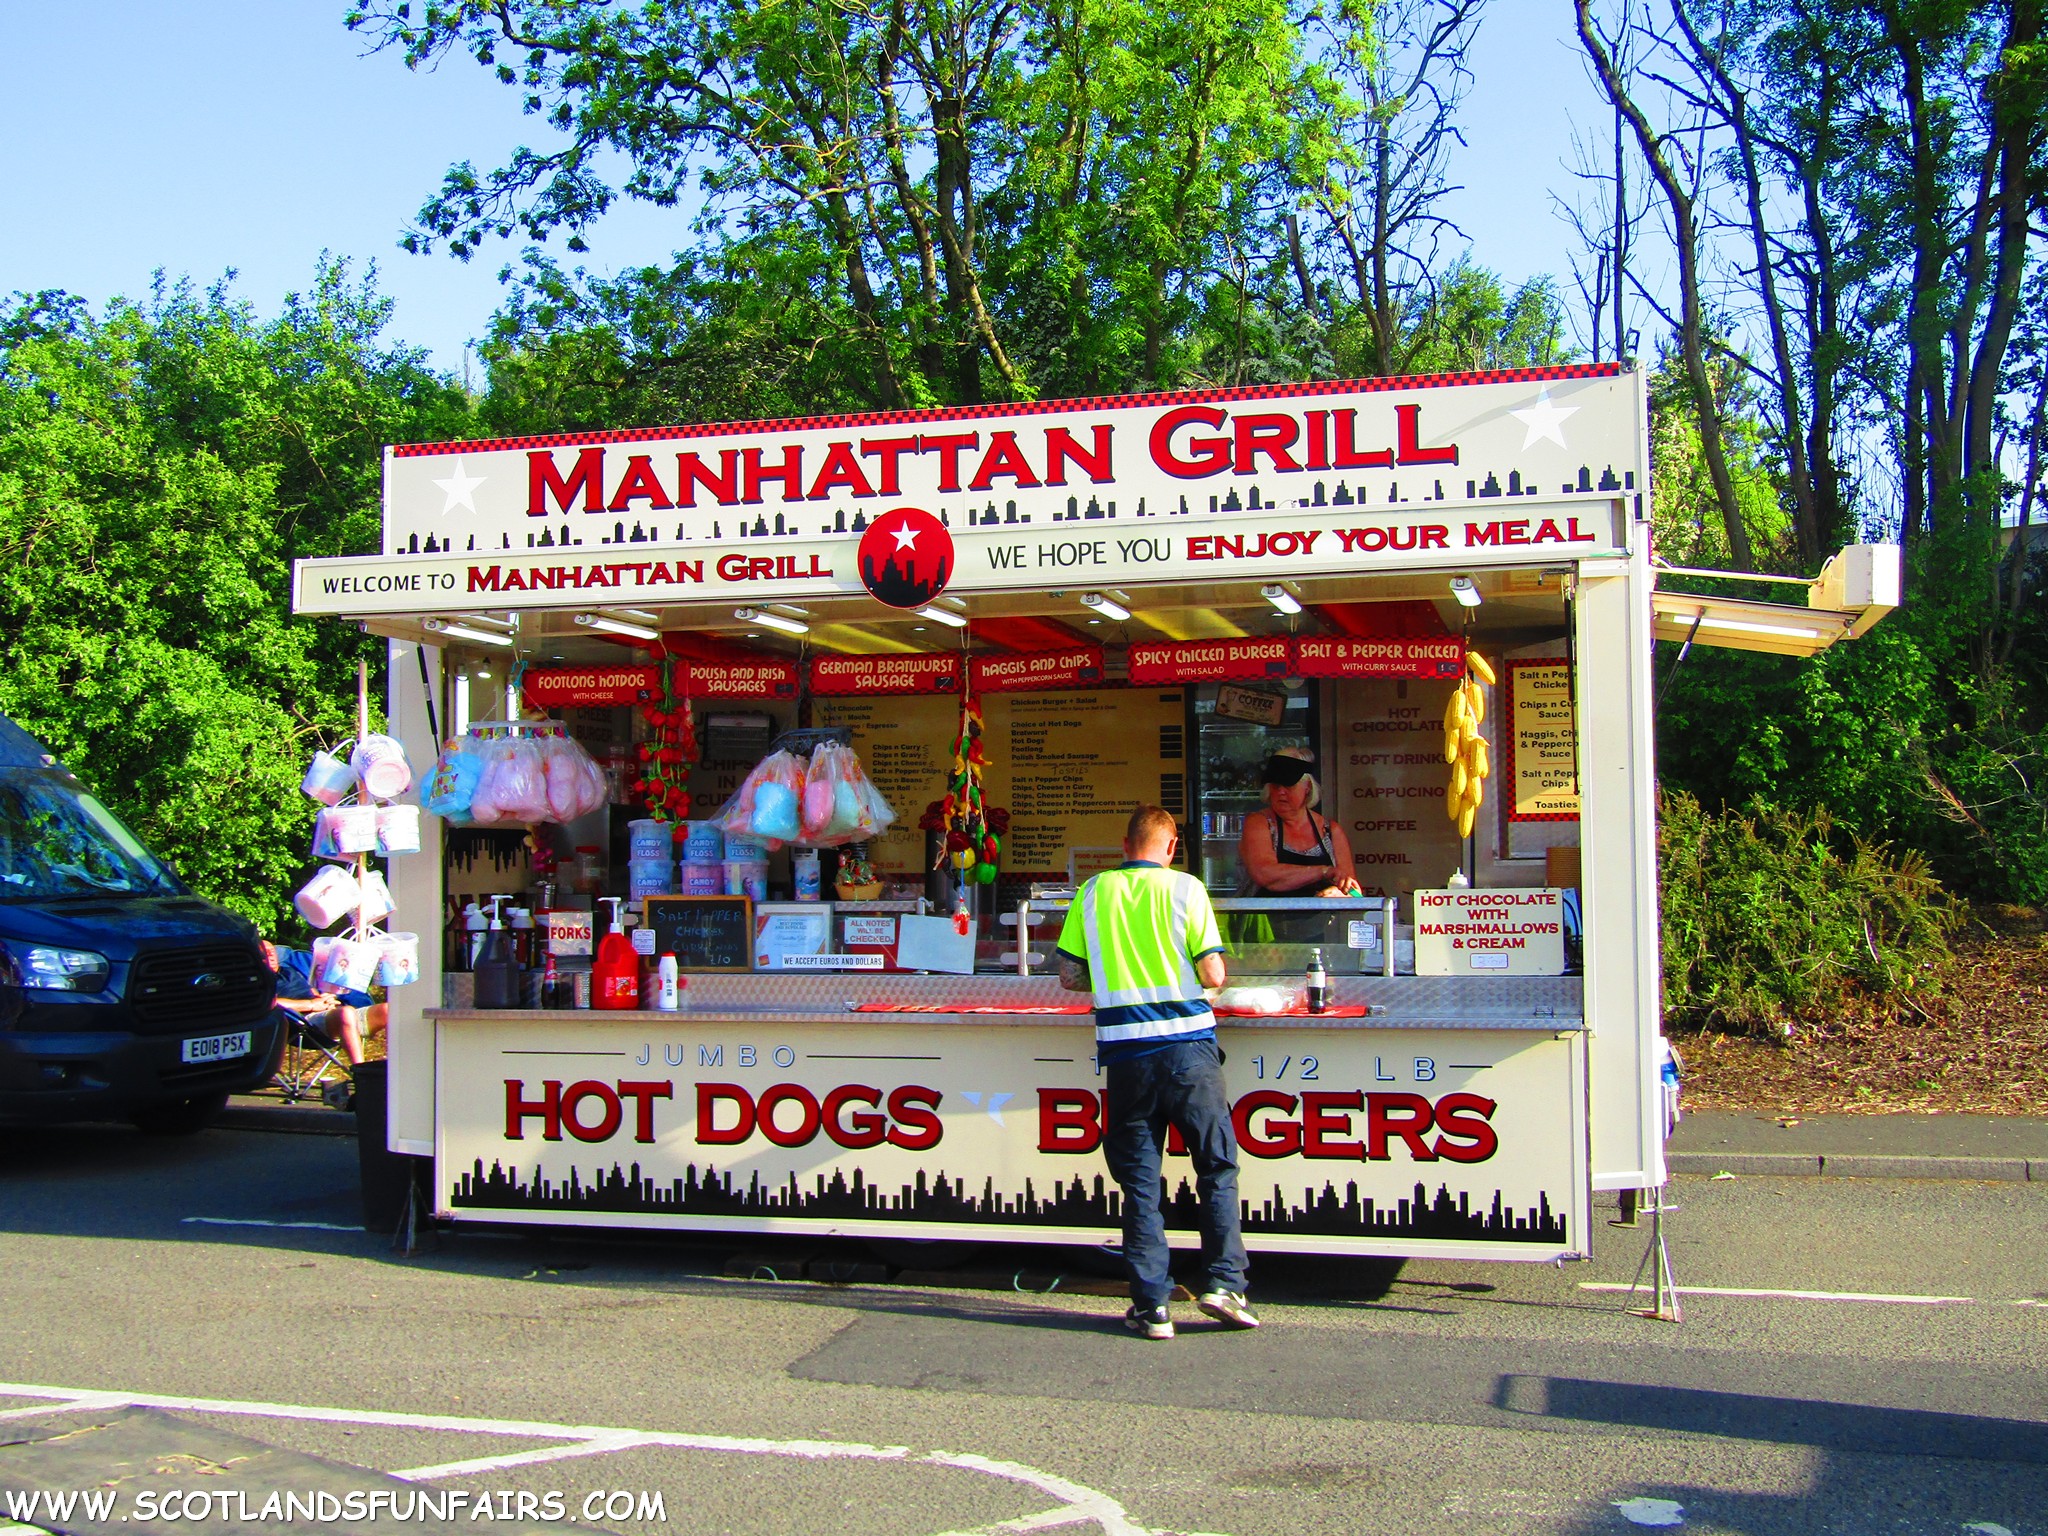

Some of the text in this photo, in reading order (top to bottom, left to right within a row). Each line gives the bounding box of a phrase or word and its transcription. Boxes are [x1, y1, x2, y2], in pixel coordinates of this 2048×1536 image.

[526, 404, 1459, 518] MANHATTAN GRILL
[987, 517, 1595, 569] WE HOPE YOU ENJOY YOUR MEAL
[323, 553, 833, 594] WELCOME TO MANHATTAN GRILL
[1229, 643, 1285, 660] BURGER
[1300, 643, 1331, 658] SALT
[1336, 644, 1348, 658] &
[1352, 644, 1403, 659] PEPPER
[1175, 665, 1225, 676] WITH SALAD
[1342, 662, 1417, 672] WITH CURRY SAUCE
[1001, 672, 1073, 685] WITH PEPPERCORN SAUCE
[1520, 671, 1540, 680] Salt
[1533, 681, 1568, 689] Chicke
[572, 691, 614, 700] WITH CHEESE
[1042, 698, 1067, 706] Burger
[1520, 701, 1548, 710] Chips
[1388, 707, 1421, 718] HOT
[1539, 710, 1570, 718] Sauce
[1352, 720, 1444, 732] CHOCOLATE
[1520, 730, 1558, 740] Haggis,
[1520, 740, 1528, 748] &
[900, 752, 921, 760] Gravy
[1540, 750, 1571, 758] Sauce
[1350, 754, 1390, 765] SOFT
[1522, 770, 1541, 778] Salt
[718, 775, 736, 788] IN
[1541, 780, 1570, 789] Chips
[1073, 792, 1095, 800] Gravy
[1353, 787, 1445, 798] CAPPUCINO
[1073, 800, 1116, 808] Peppercorn
[1535, 801, 1578, 809] Toasties
[1037, 809, 1062, 817] Haggis
[1071, 808, 1114, 816] Peppercorn
[1042, 825, 1067, 833] Burger
[1354, 820, 1417, 831] COFFEE
[1037, 833, 1062, 841] Burger
[636, 839, 662, 847] CANDY
[689, 839, 716, 847] CANDY
[1040, 841, 1065, 849] Burger
[636, 849, 660, 857] FLOSS
[690, 849, 714, 857] FLOSS
[731, 848, 755, 857] FLOSS
[1012, 858, 1051, 866] Any Filling
[1355, 853, 1413, 864] BOVRIL
[637, 879, 663, 887] CANDY
[689, 878, 716, 886] CANDY
[690, 888, 714, 896] FLOSS
[1421, 893, 1557, 906] HOT CHOCOLATE
[1467, 909, 1509, 920] WITH
[850, 919, 891, 927] ALL NOTES
[550, 926, 591, 940] FORKS
[1420, 922, 1559, 935] MARSHMALLOWS
[850, 935, 891, 943] CHECKED
[1452, 937, 1526, 949] & CREAM
[784, 957, 883, 966] WE ACCEPT EUROS AND DOLLARS
[222, 1035, 245, 1054] PSX
[636, 1043, 796, 1068] JUMBO
[1251, 1055, 1319, 1081] 1/2
[504, 1078, 943, 1152] HOT DOGS
[1036, 1087, 1499, 1164] BGERS
